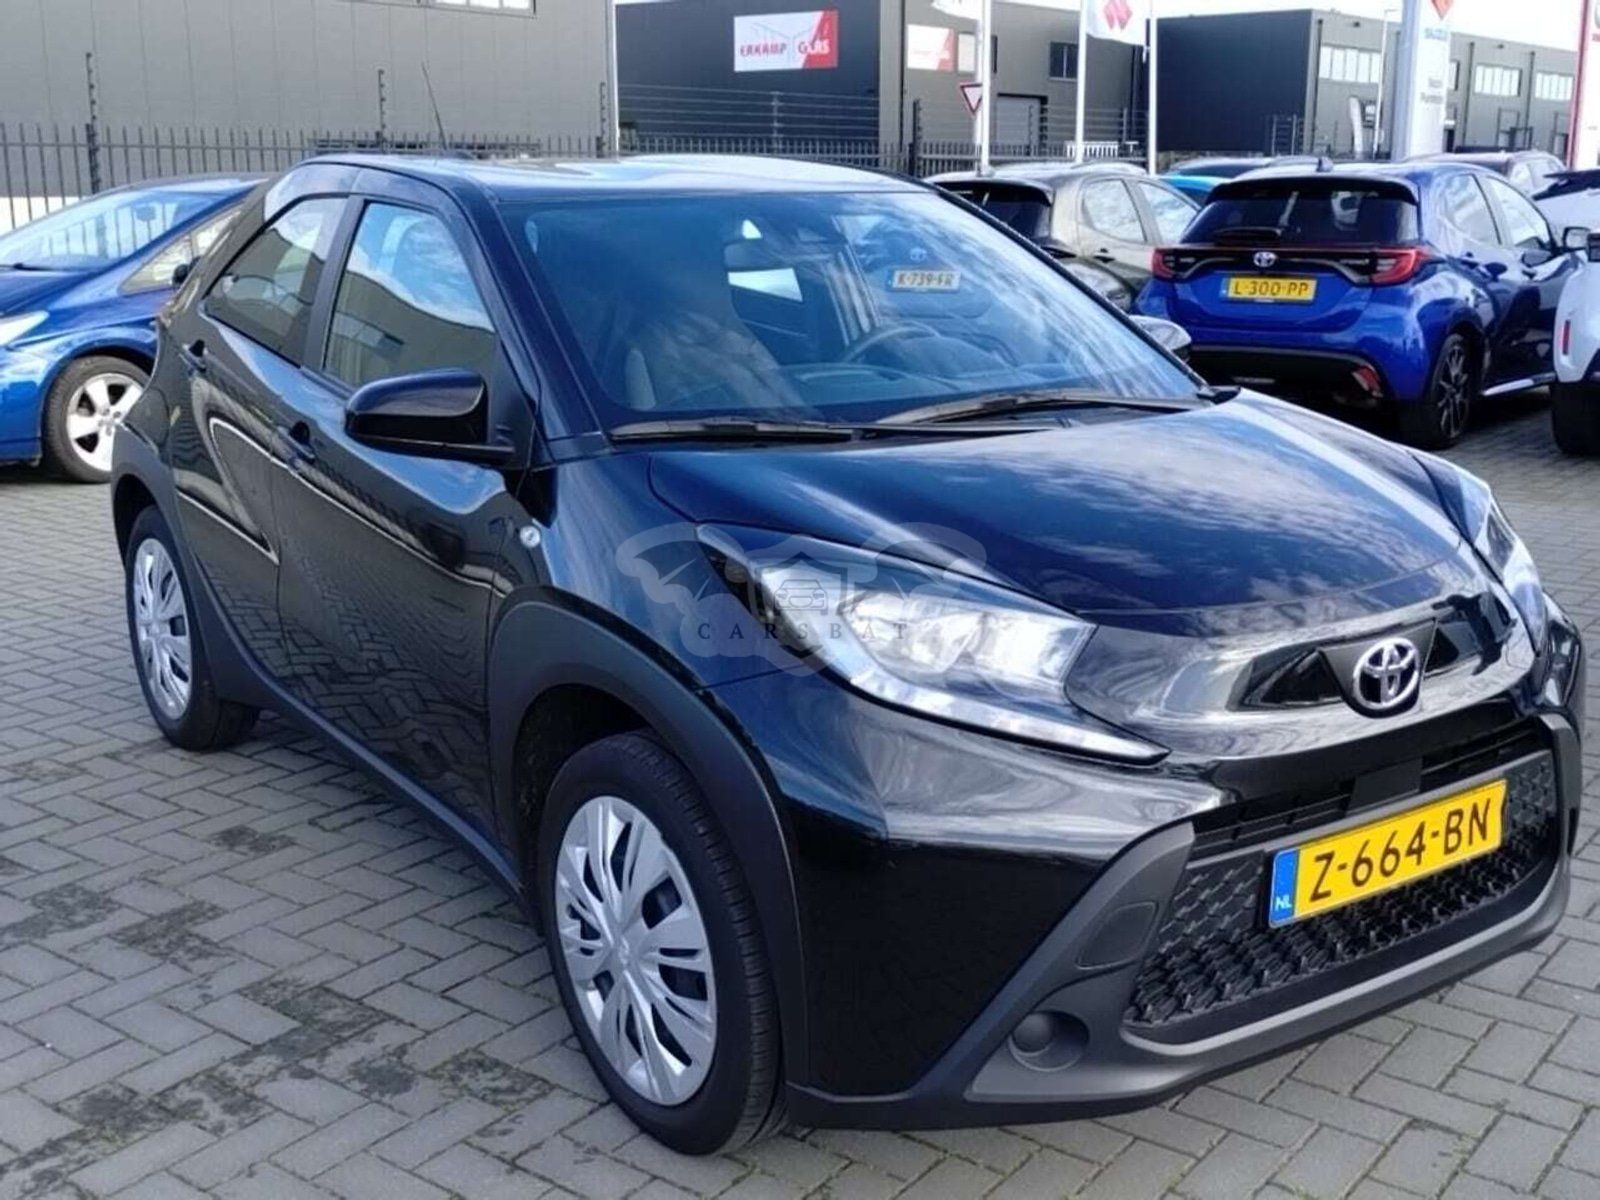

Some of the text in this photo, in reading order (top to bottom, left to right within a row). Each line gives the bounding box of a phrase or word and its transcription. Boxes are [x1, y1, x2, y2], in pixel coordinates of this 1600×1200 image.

[1234, 281, 1309, 296] L-300-PP
[1310, 798, 1491, 902] Z-664-BN
[1275, 896, 1292, 910] NL
